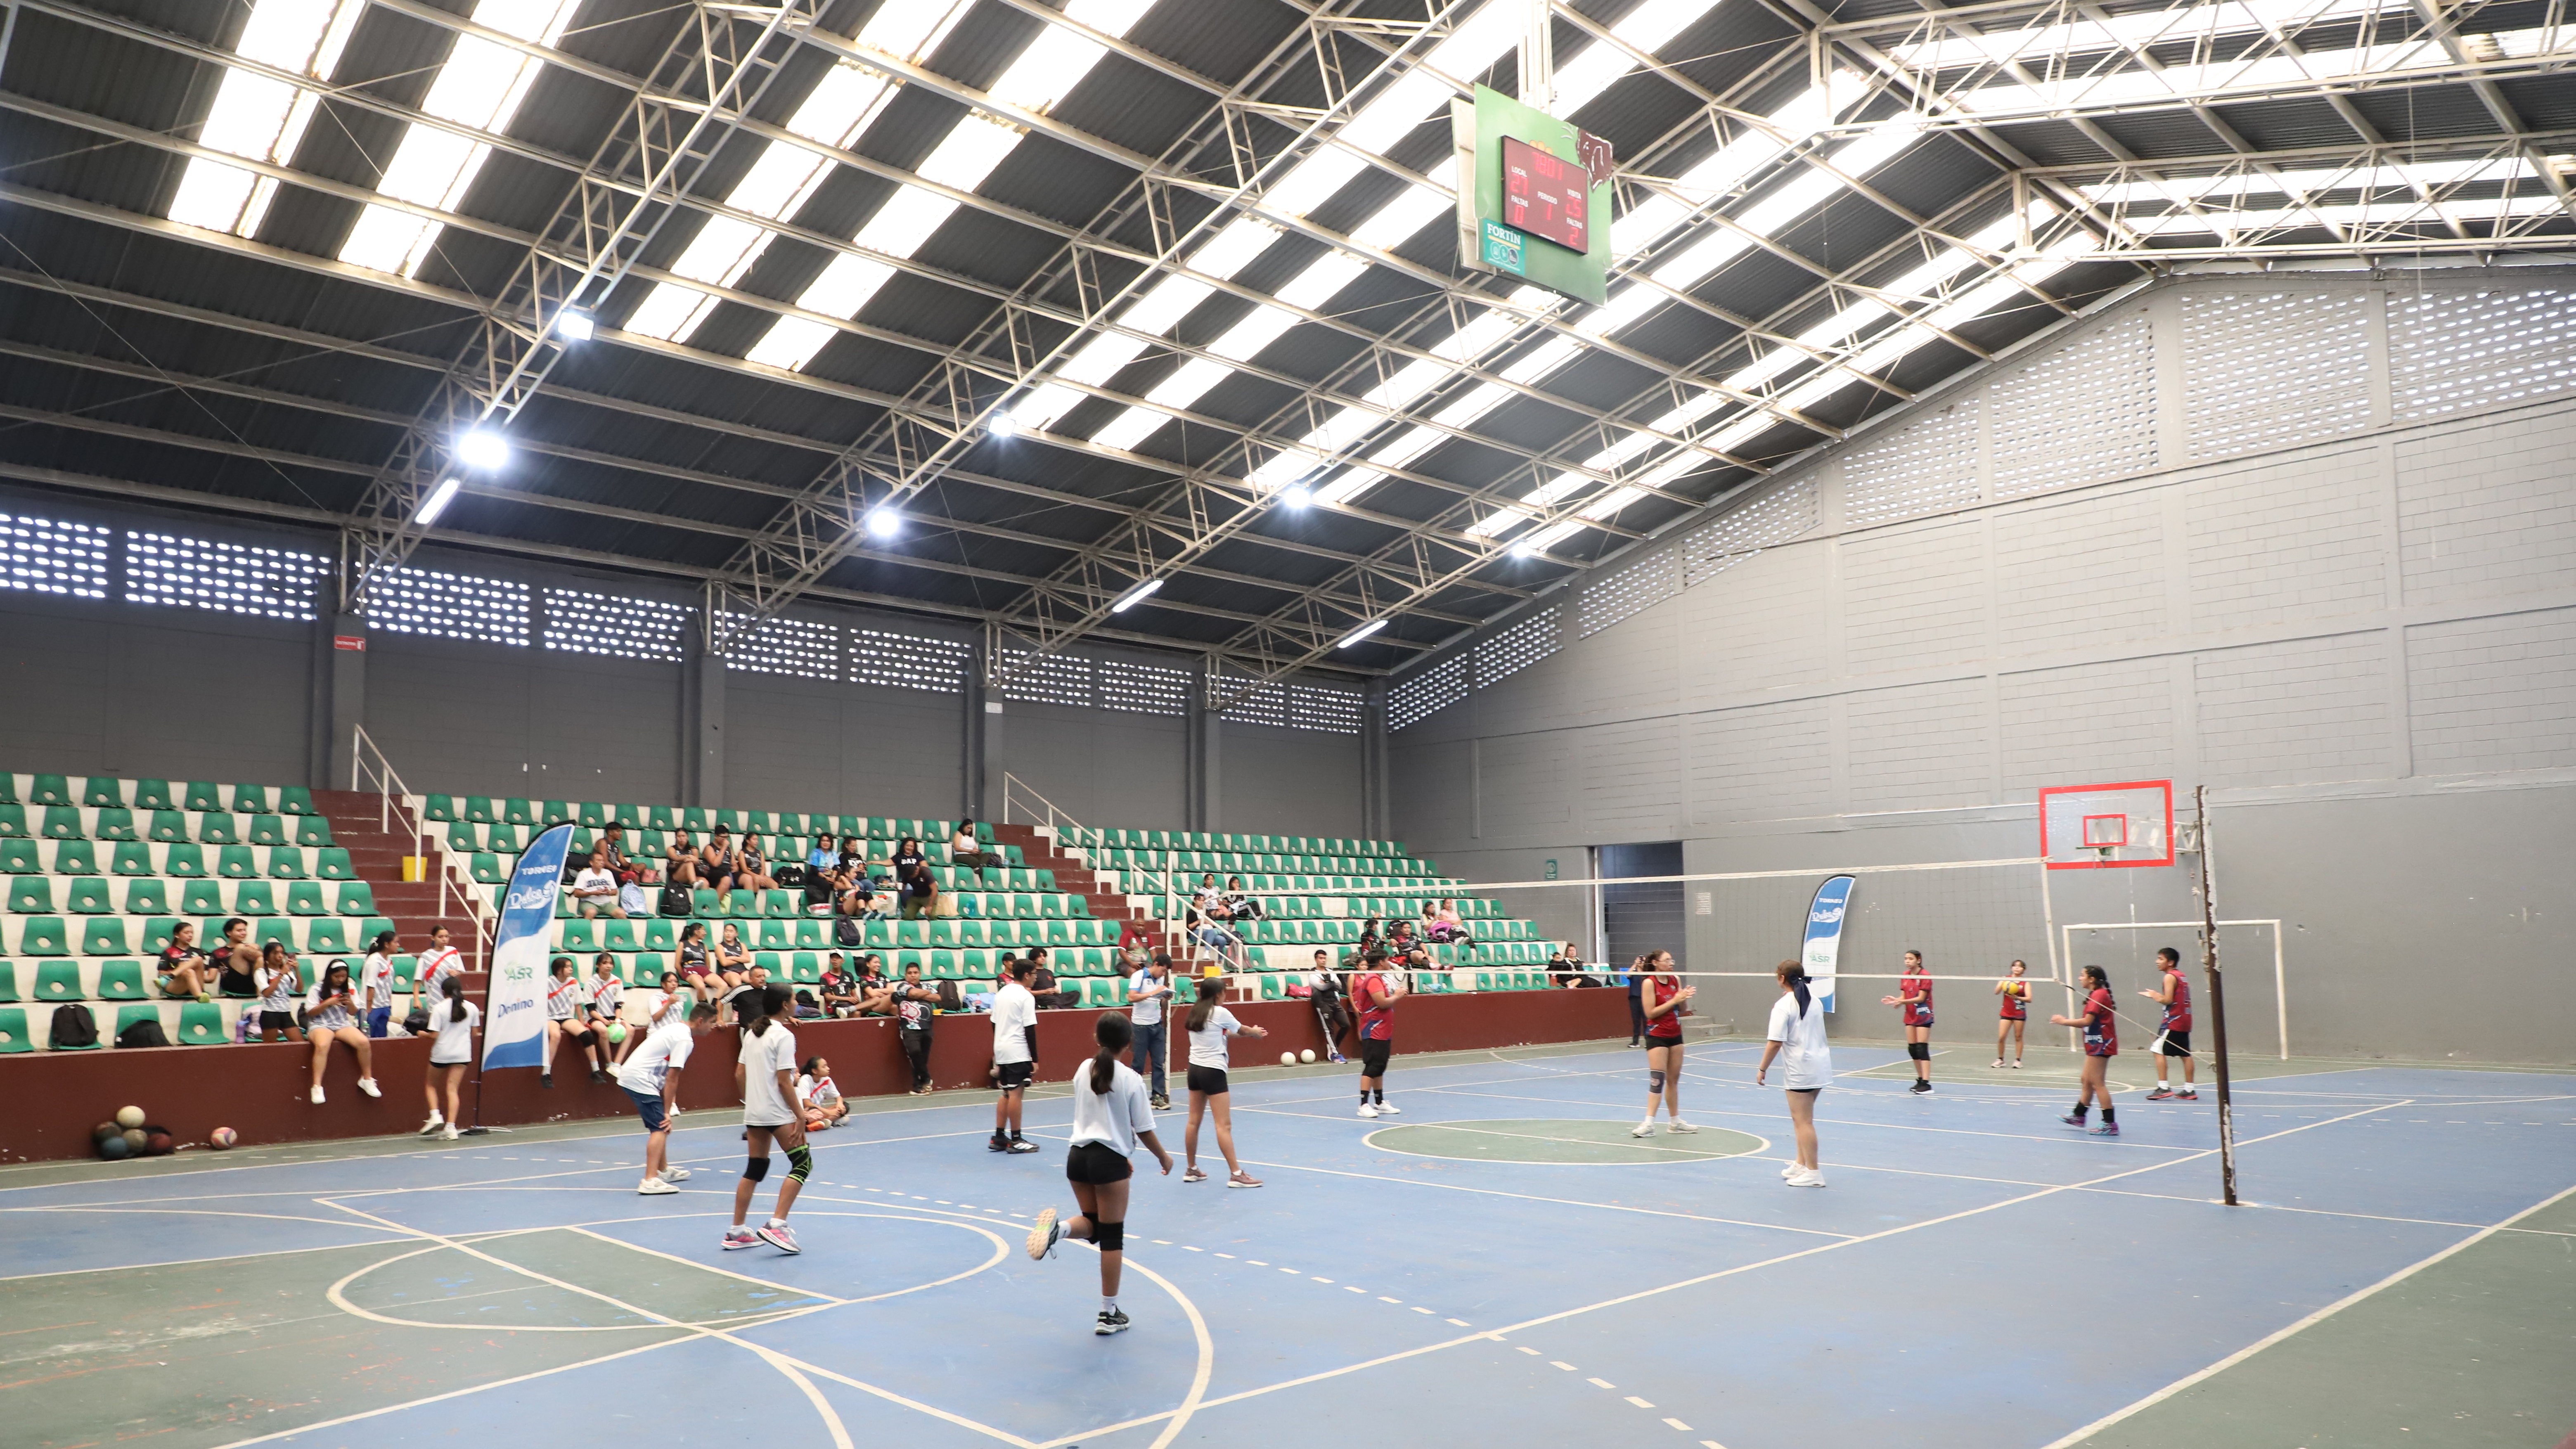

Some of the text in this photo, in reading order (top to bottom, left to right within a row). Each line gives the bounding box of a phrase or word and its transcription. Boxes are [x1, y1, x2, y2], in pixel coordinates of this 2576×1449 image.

[1511, 166, 1527, 178] LOCAL
[1537, 191, 1558, 205] PERIODO
[1567, 188, 1582, 200] VISITA
[1511, 195, 1529, 208] FALTAS
[1566, 217, 1583, 229] FALTAS
[1487, 223, 1521, 245] FORTÍN
[1569, 227, 1579, 246] 2
[506, 966, 533, 981] ASR
